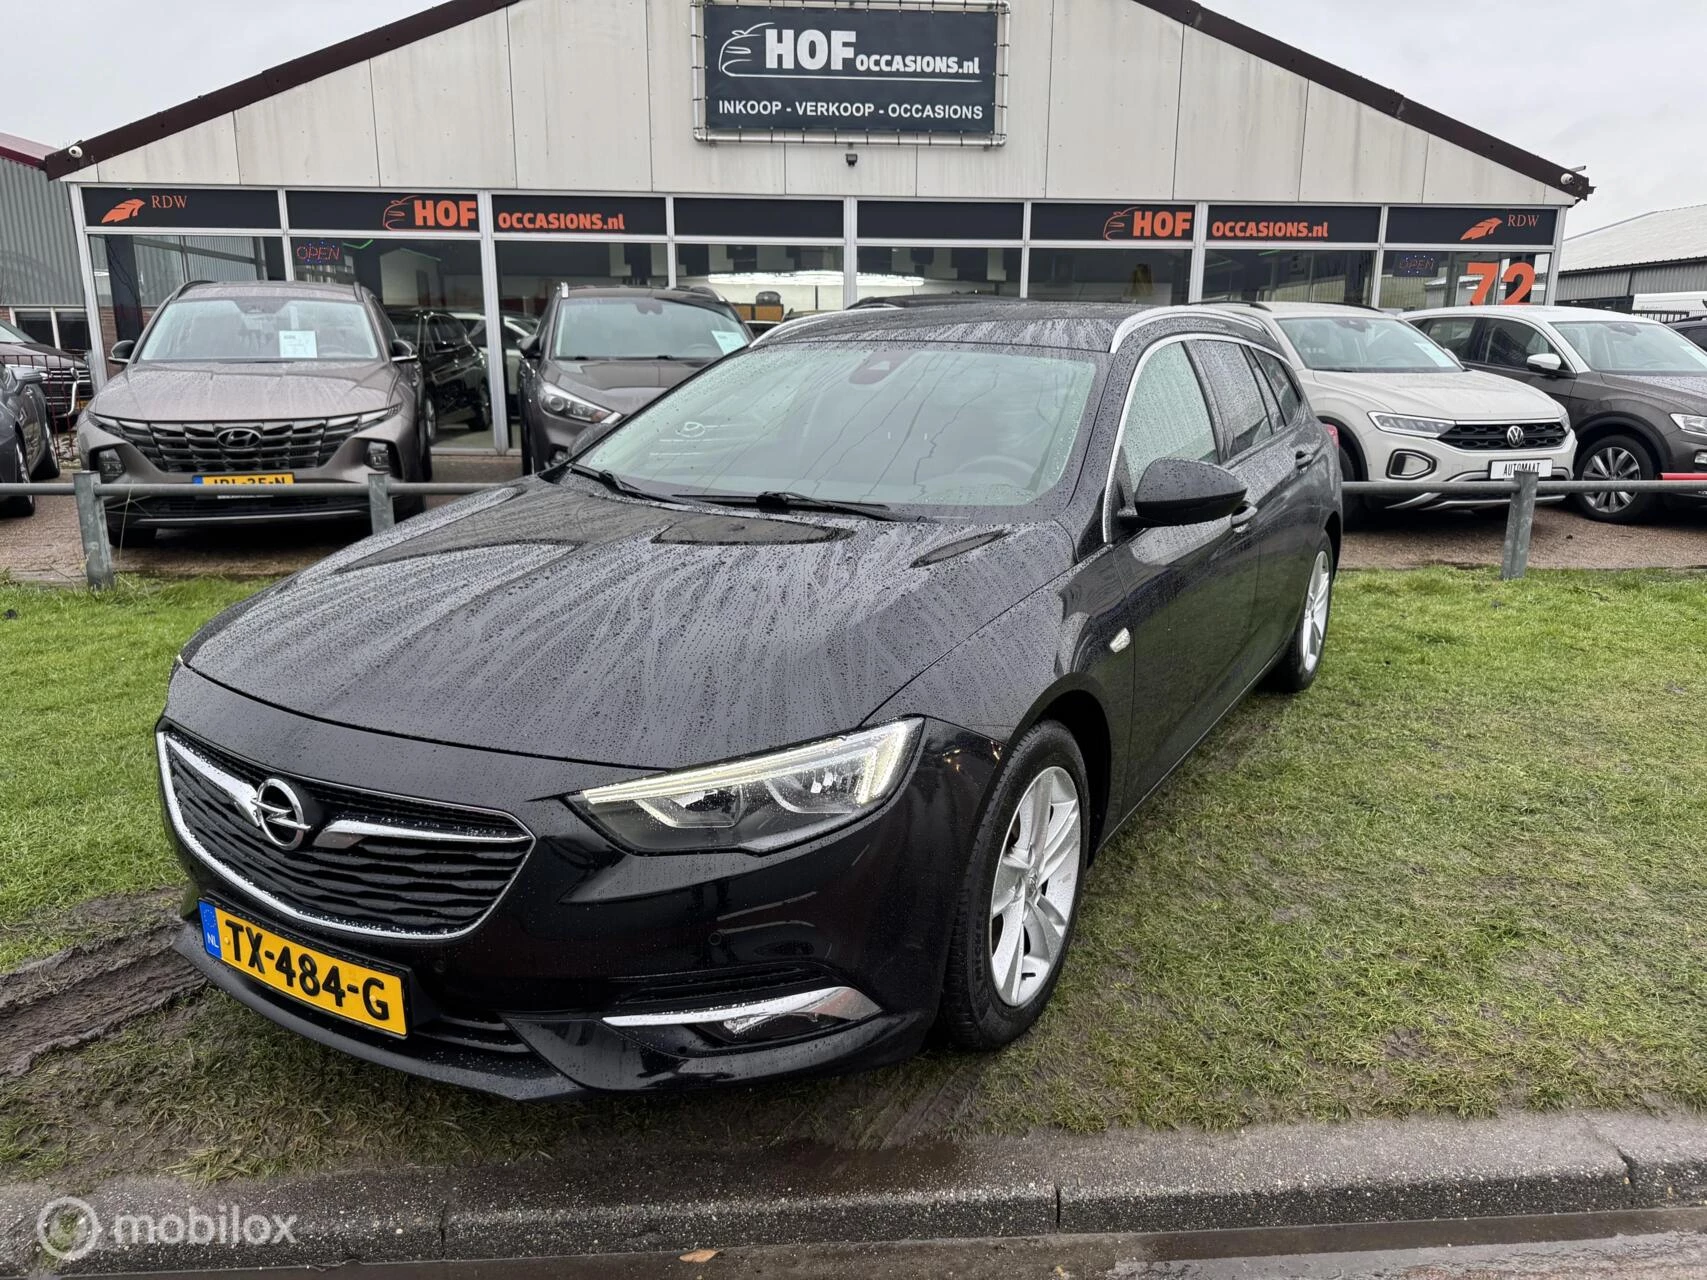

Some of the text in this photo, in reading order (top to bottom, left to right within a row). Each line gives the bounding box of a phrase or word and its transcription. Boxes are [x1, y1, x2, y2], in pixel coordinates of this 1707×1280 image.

[765, 29, 980, 74] HOF OCCASIONS.nl
[718, 100, 782, 115] INKOOP
[795, 102, 874, 117] VERKOOP
[888, 103, 983, 119] OCCASIONS
[151, 195, 188, 209] RDW
[413, 199, 625, 230] HOF OCCASIONS.nl
[1132, 211, 1329, 238] HOF OCCASIONS.nl
[1507, 214, 1540, 227] RDW
[296, 246, 340, 261] OPEN
[1466, 261, 1536, 306] 72
[207, 934, 220, 948] NL
[225, 918, 390, 1021] TX-484-G
